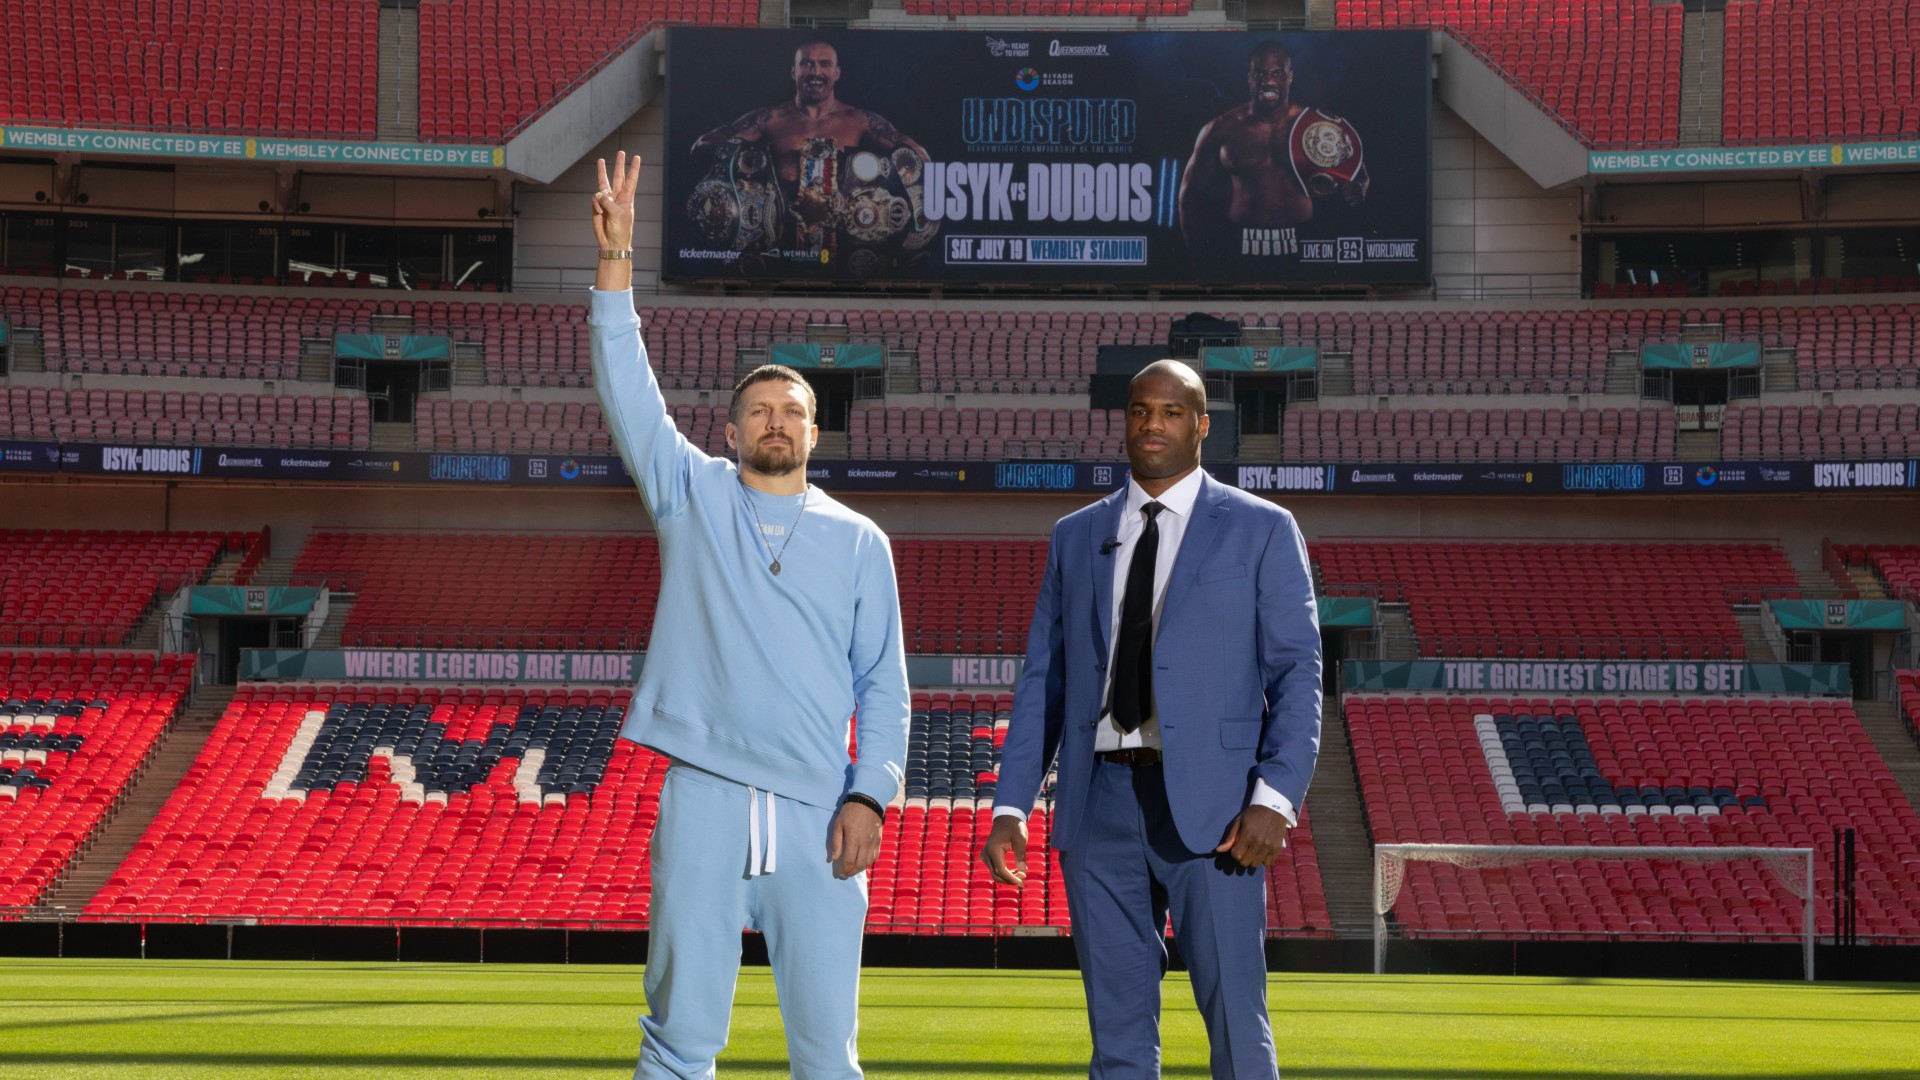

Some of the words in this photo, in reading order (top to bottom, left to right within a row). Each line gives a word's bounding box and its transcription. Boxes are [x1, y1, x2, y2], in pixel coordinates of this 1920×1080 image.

[962, 98, 1136, 144] UNDISPUTED
[9, 131, 89, 147] WEMBLEY
[92, 136, 195, 152] CONNECTED
[200, 141, 221, 153] BY
[224, 142, 241, 154] EE
[261, 143, 338, 158] WEMBLEY
[342, 146, 444, 162] CONNECTED
[448, 150, 468, 162] BY
[471, 151, 488, 163] EE
[1592, 154, 1671, 169] WEMBLEY
[1675, 151, 1779, 167] CONNECTED
[1784, 150, 1805, 163] BY
[1809, 149, 1827, 162] EE
[1848, 145, 1920, 161] WEMBLE
[923, 162, 1014, 221] USYK
[1027, 162, 1152, 221] DUBOIS
[477, 234, 496, 243] 3037
[1241, 239, 1298, 256] DUBOIS
[679, 247, 741, 259] ticketmaster
[951, 239, 973, 259] SAT
[976, 239, 1005, 260] JULY
[1009, 239, 1023, 260] 19
[1031, 240, 1085, 260] WEMBLEY
[1090, 240, 1143, 260] STADIUM
[1303, 243, 1320, 259] LIVE
[1322, 243, 1333, 259] ON
[1366, 243, 1415, 258] WORLDWIDE
[386, 339, 399, 347] 212
[821, 348, 834, 356] 213
[1694, 348, 1708, 356] 215
[1254, 351, 1267, 359] 214
[103, 447, 137, 470] USYK
[142, 448, 190, 472] DUBOIS
[281, 457, 331, 468] ticketmaster
[429, 455, 510, 480] UNDISPUTED
[848, 469, 897, 477] ticketmaster
[995, 464, 1075, 488] UNDISPUTED
[1238, 466, 1272, 489] USYK
[1276, 466, 1324, 489] DUBOIS
[1413, 471, 1463, 481] ticketmaster
[1563, 465, 1644, 489] UNDISPUTED
[1814, 463, 1850, 487] USYK
[1855, 462, 1904, 486] DUBOIS
[249, 592, 263, 600] 110
[1828, 606, 1844, 614] 113
[344, 651, 420, 679] WHERE
[426, 652, 519, 679] LEGENDS
[524, 654, 566, 680] ARE
[571, 654, 632, 680] MADE
[952, 659, 1015, 685] HELLO
[1444, 662, 1486, 689] THE
[1490, 663, 1596, 690] GREATEST
[1602, 663, 1670, 690] STAGE
[1675, 663, 1697, 690] IS
[1703, 664, 1744, 690] SET
